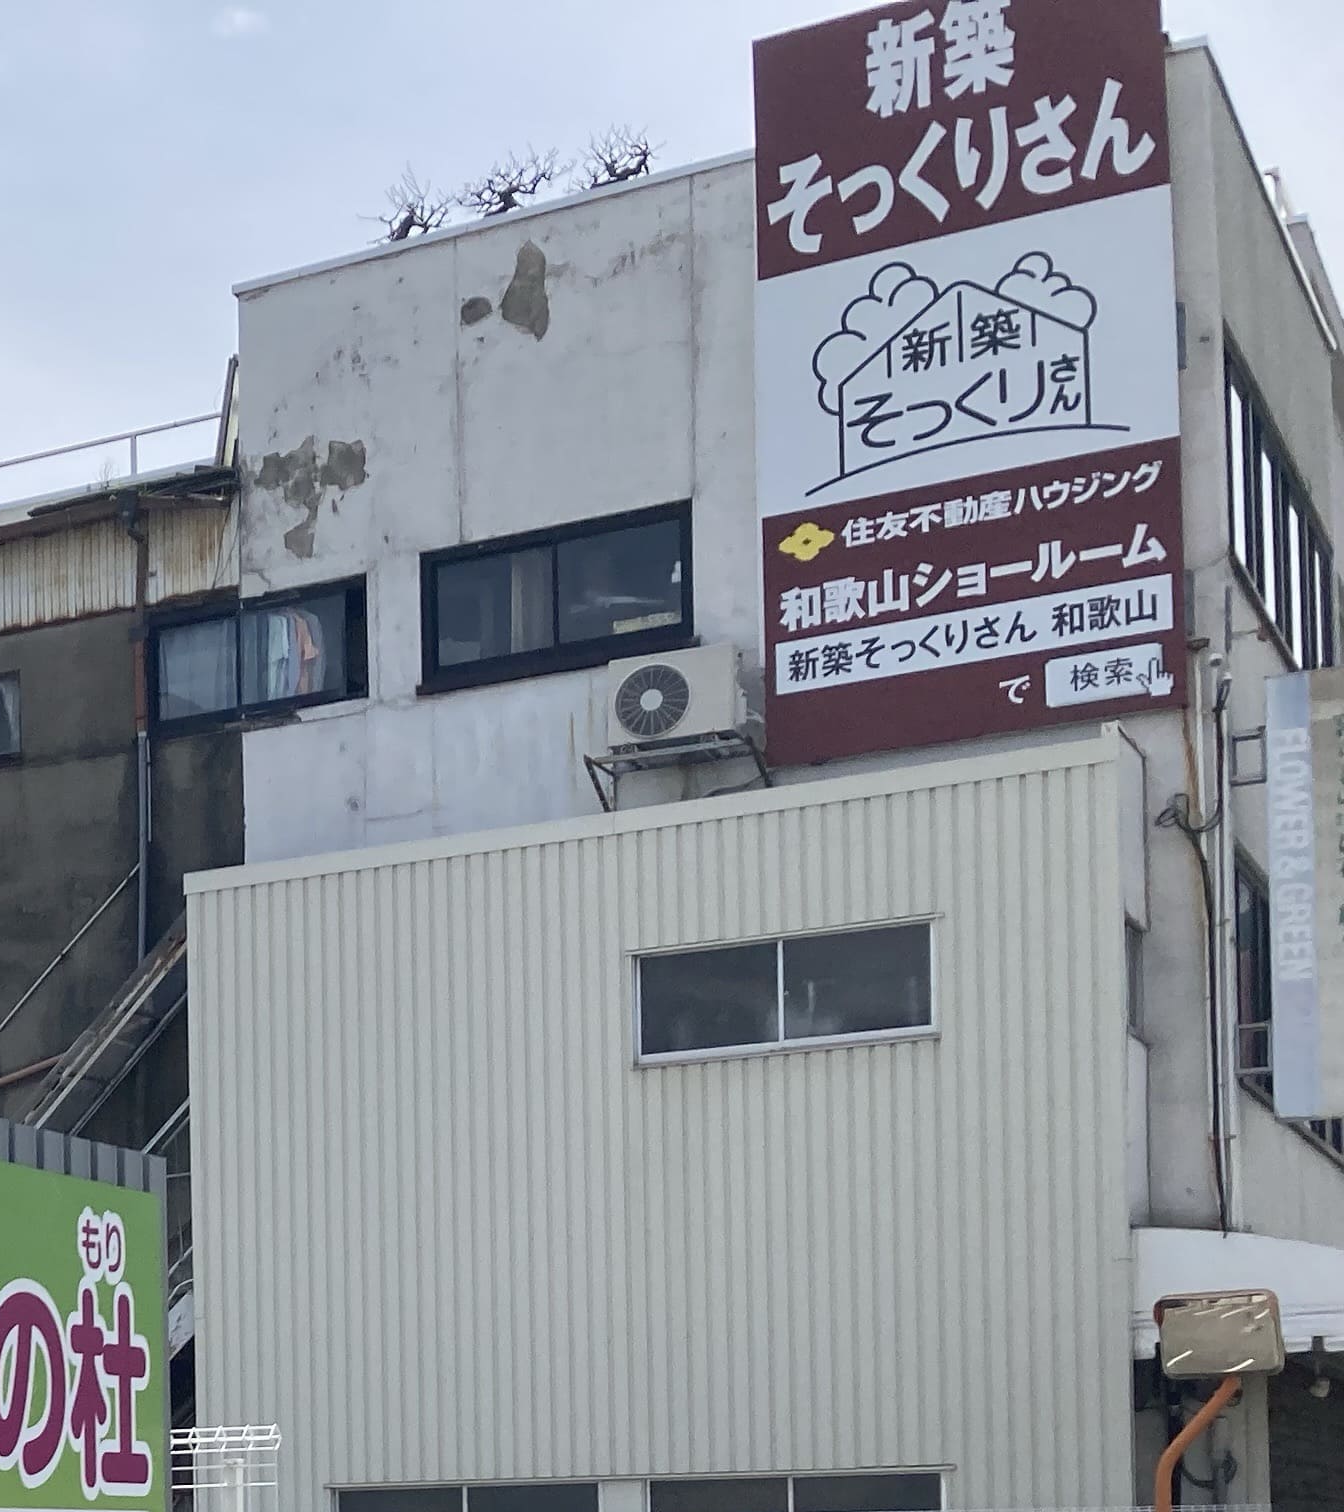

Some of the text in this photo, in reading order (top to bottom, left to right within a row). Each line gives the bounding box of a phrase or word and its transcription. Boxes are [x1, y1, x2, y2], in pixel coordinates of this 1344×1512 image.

[865, 0, 1015, 119] 新築
[767, 77, 1156, 254] そっくりさん
[902, 308, 1022, 374] 新築
[841, 460, 1163, 548] 住友不動産ハウジング
[779, 522, 1167, 632] 和歌山ショールーム
[787, 589, 1158, 683] 新築そっくりさん 和歌山
[998, 656, 1136, 704] で 検索
[80, 1217, 123, 1273] もり
